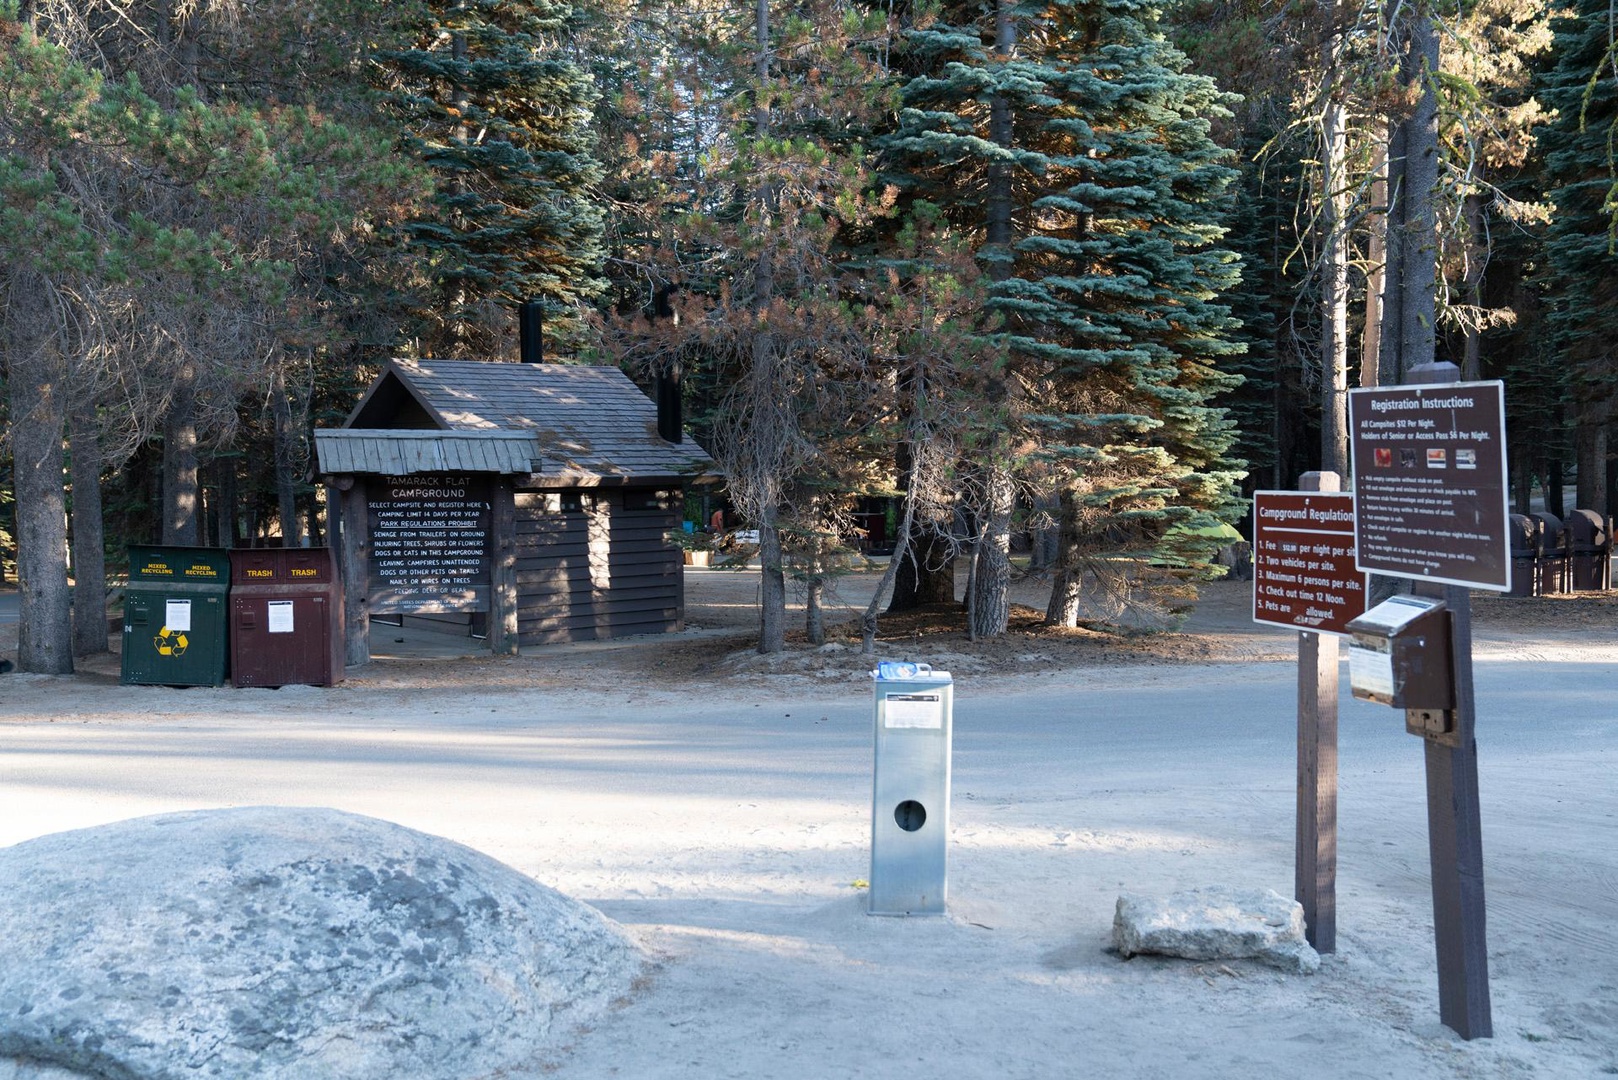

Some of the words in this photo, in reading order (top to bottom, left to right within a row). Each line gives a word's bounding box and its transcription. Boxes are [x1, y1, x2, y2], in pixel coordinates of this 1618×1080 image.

[1371, 398, 1419, 413] Registration
[1421, 397, 1474, 409] Instructions
[1368, 420, 1395, 430] Campsites
[1417, 419, 1435, 429] Night.
[1361, 432, 1380, 440] Holders
[1381, 432, 1388, 440] of
[1388, 432, 1406, 440] Senior
[1415, 432, 1434, 440] Access
[1435, 432, 1448, 440] Pass
[1458, 432, 1469, 440] Per
[1470, 431, 1490, 442] Night.
[386, 477, 438, 486] TAMARACK
[445, 478, 471, 486] FLAT
[392, 489, 465, 498] CAMPGROUND
[1259, 507, 1306, 522] Campground
[1309, 510, 1354, 524] Regulation
[1258, 540, 1263, 549] 1.
[1265, 541, 1276, 550] Fee
[1299, 545, 1310, 555] per
[1312, 545, 1330, 557] night
[1332, 548, 1344, 558] per
[1346, 547, 1355, 556] sit
[1266, 556, 1279, 566] Two
[1280, 558, 1306, 568] vehicles
[1307, 562, 1319, 571] per
[1320, 561, 1336, 571] site.
[1258, 571, 1264, 579] 3.
[1265, 572, 1296, 583] Maximum
[1297, 575, 1302, 583] 6
[1303, 578, 1329, 588] persons
[1331, 580, 1343, 590] per
[1345, 580, 1362, 590] site.
[1258, 585, 1264, 594] 4.
[1265, 586, 1284, 597] Check
[1285, 589, 1297, 598] out
[1298, 590, 1314, 600] time
[1316, 592, 1323, 602] 12
[1324, 594, 1346, 604] Noon.
[1258, 600, 1263, 609] 5.
[1265, 600, 1278, 610] Pets
[1280, 604, 1291, 613] are
[1305, 607, 1334, 619] allowed.
